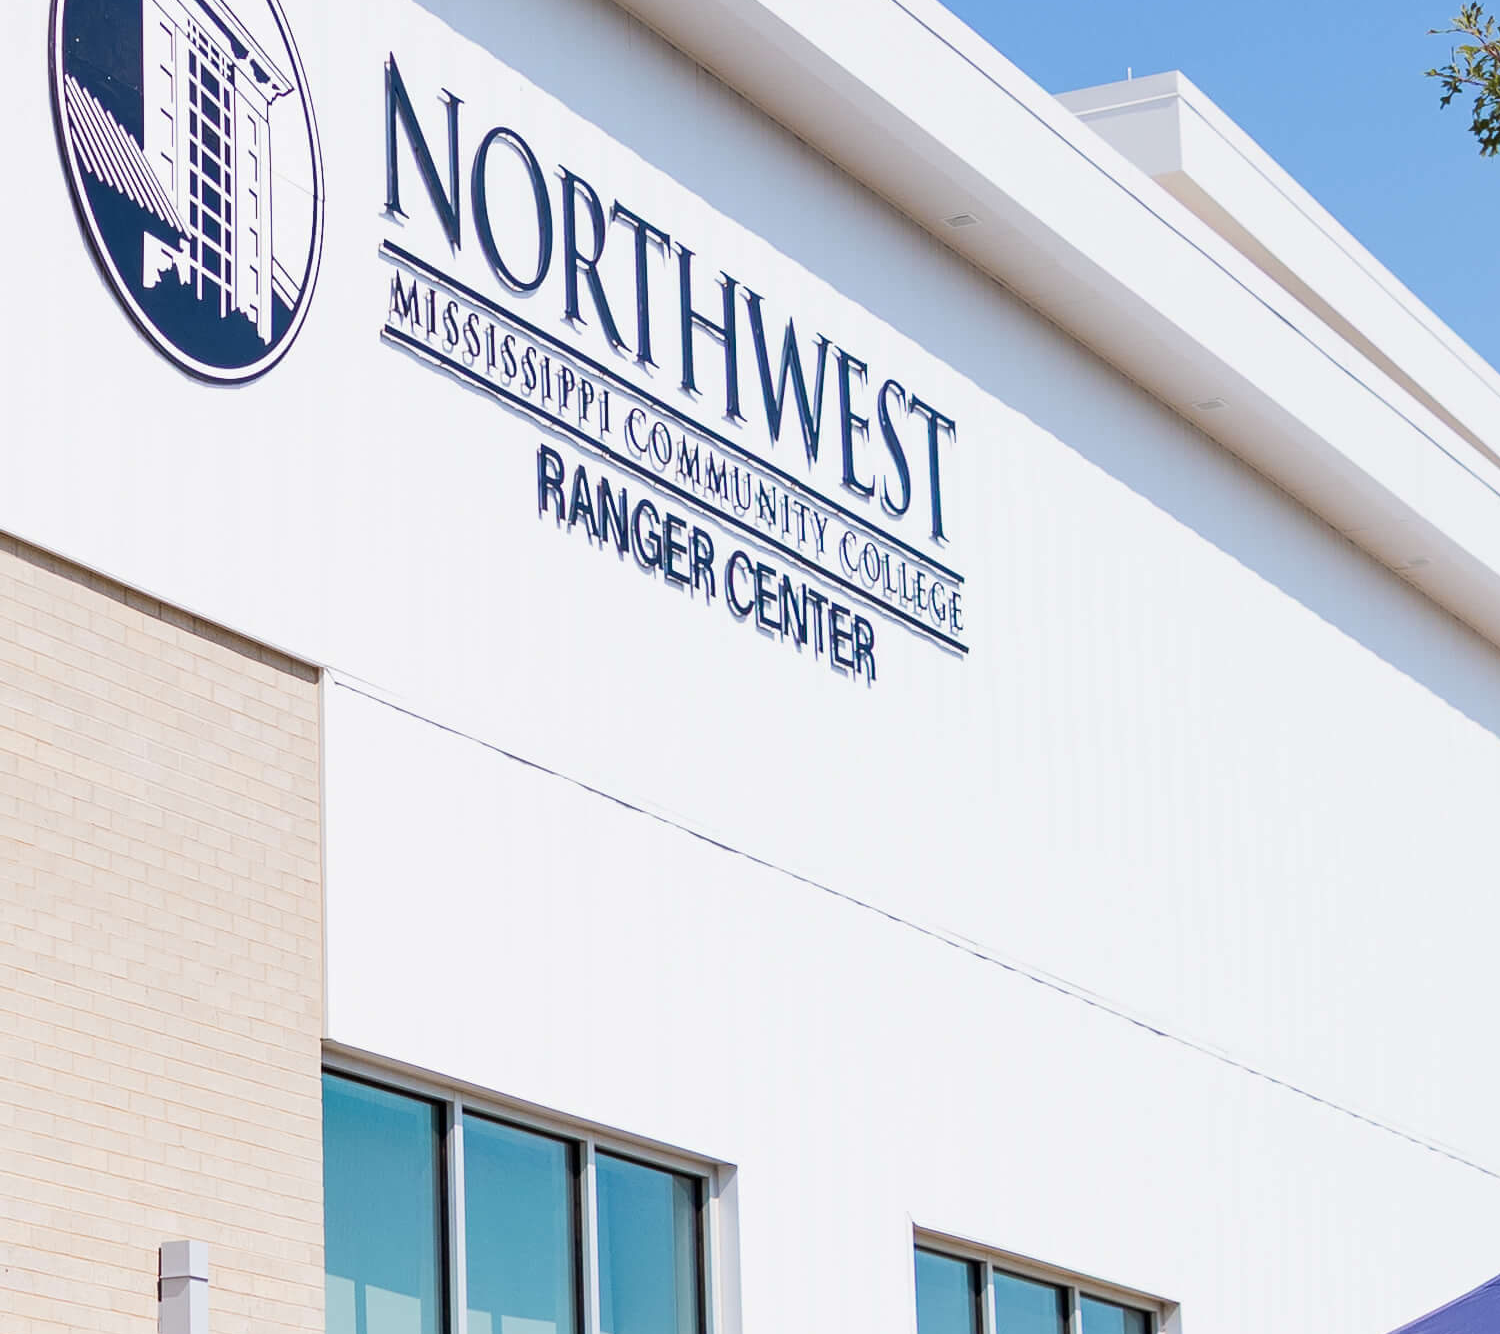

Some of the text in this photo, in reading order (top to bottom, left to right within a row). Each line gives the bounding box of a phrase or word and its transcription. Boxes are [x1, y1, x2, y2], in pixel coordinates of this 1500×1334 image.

[383, 50, 957, 544] NORTHWEST
[390, 268, 965, 632] MISSISSIPPI COMMUNITY COLLEGE
[536, 443, 877, 682] RANGER CENTER
